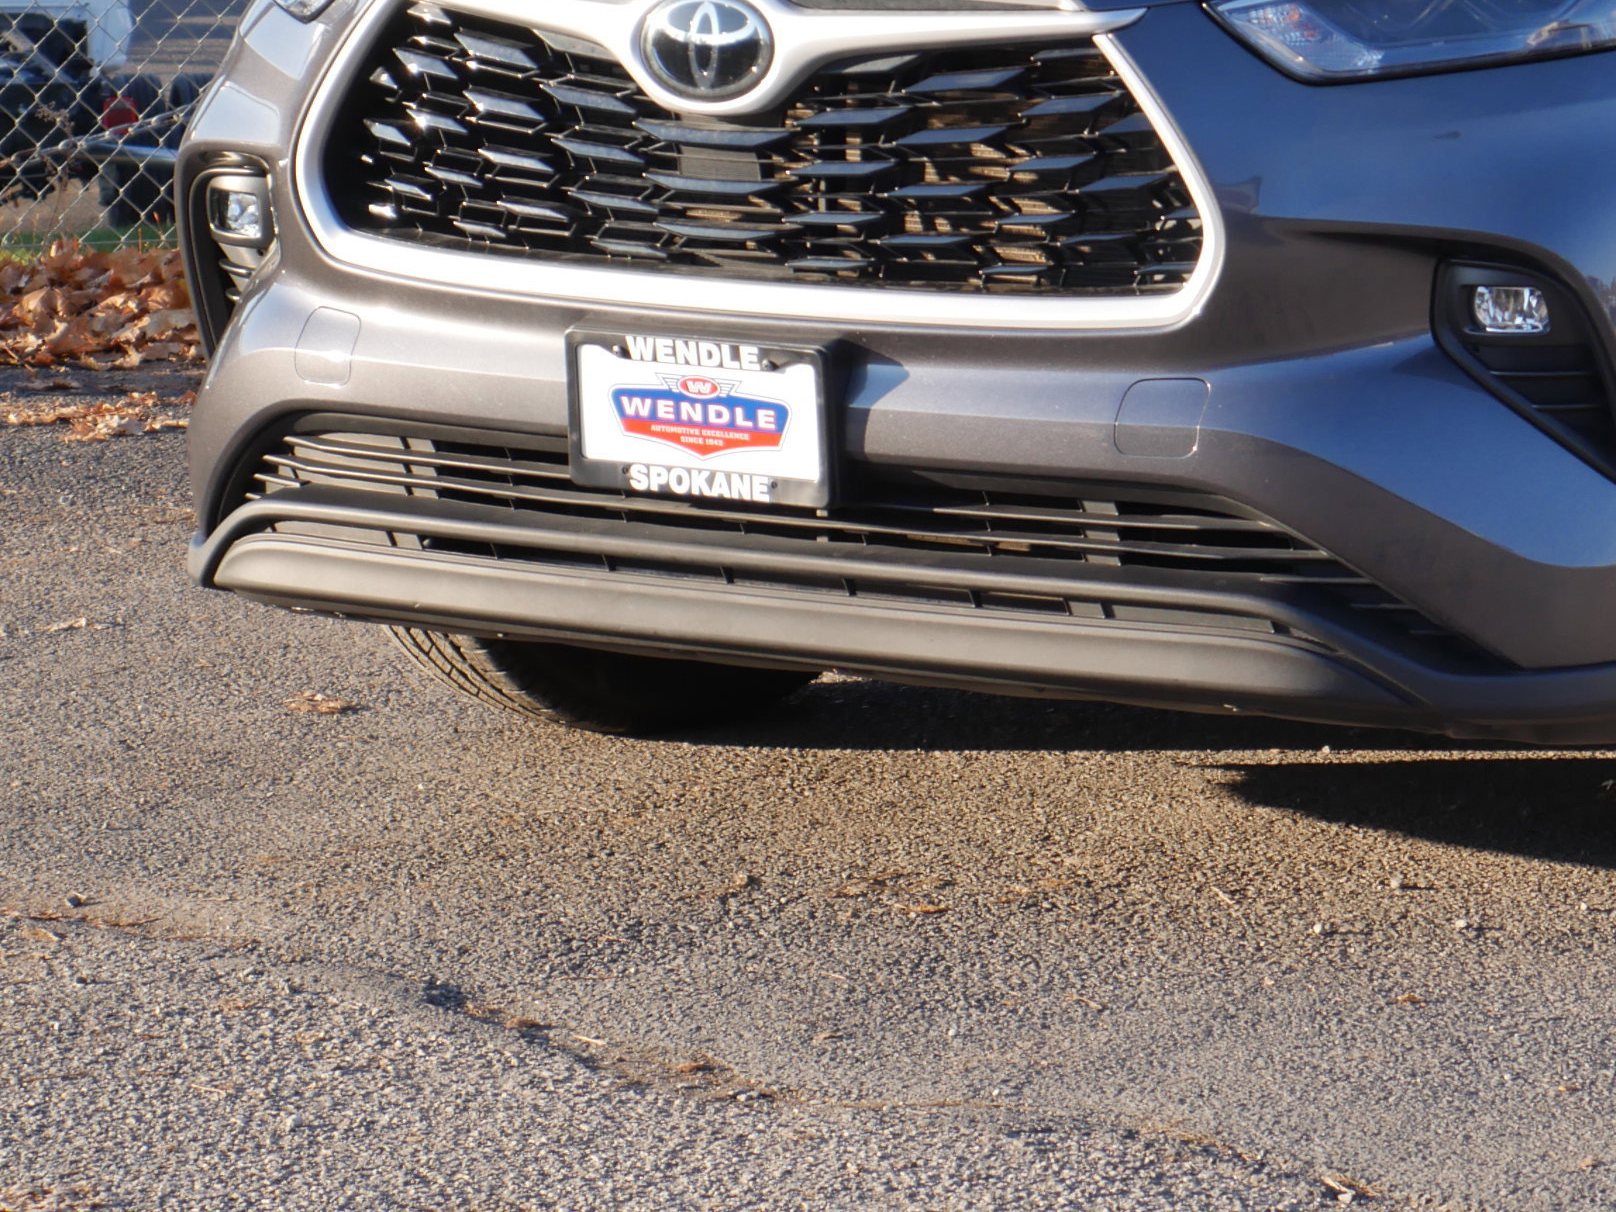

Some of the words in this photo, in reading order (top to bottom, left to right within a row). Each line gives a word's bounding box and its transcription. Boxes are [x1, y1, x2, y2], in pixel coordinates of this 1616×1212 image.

[625, 335, 762, 371] WENDLE
[620, 395, 777, 429] WENDLE
[651, 424, 700, 436] AUTOMOTIVE
[701, 429, 750, 441] EXCELLENCE
[680, 435, 704, 445] SINCE
[705, 438, 724, 447] 1943
[629, 463, 771, 503] SPOKANE
